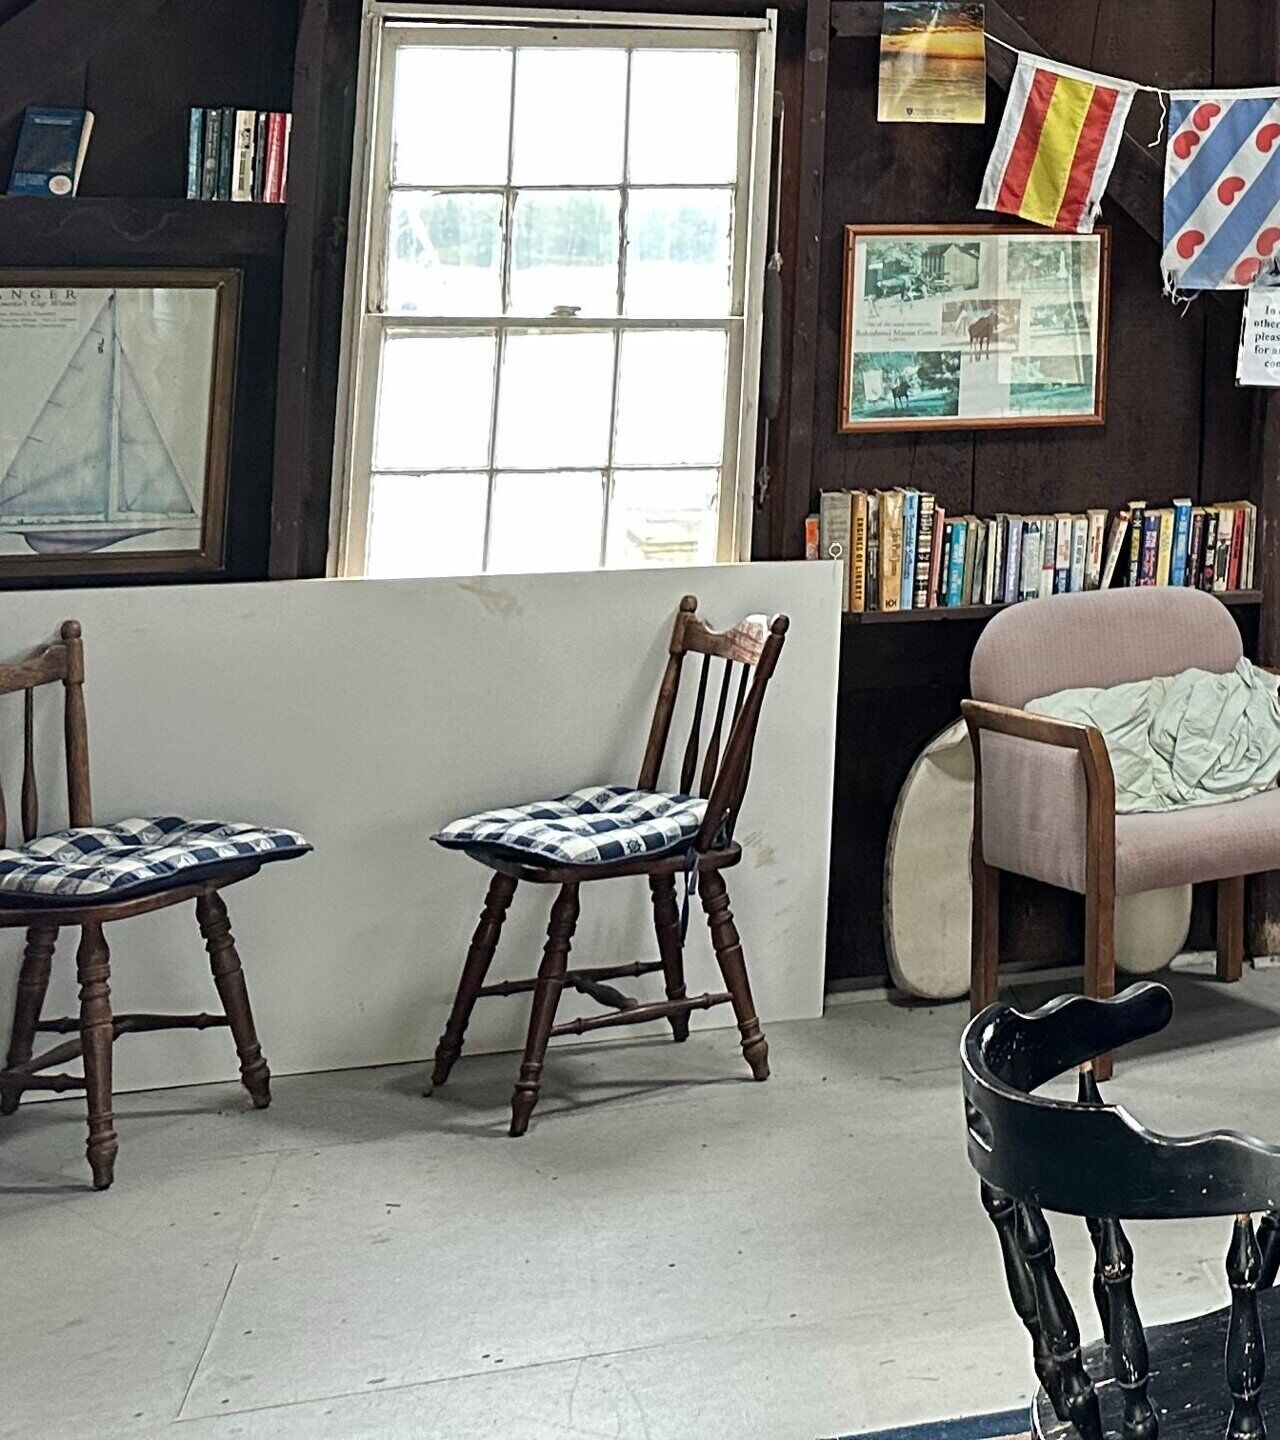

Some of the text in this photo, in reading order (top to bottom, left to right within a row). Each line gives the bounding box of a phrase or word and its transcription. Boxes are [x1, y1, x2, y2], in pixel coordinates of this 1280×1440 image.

[0, 289, 76, 300] NGER
[1265, 305, 1275, 315] In
[1254, 319, 1280, 329] other
[1254, 345, 1269, 355] for
[856, 517, 864, 553] ENGINES
[854, 566, 863, 601] LIBERTY
